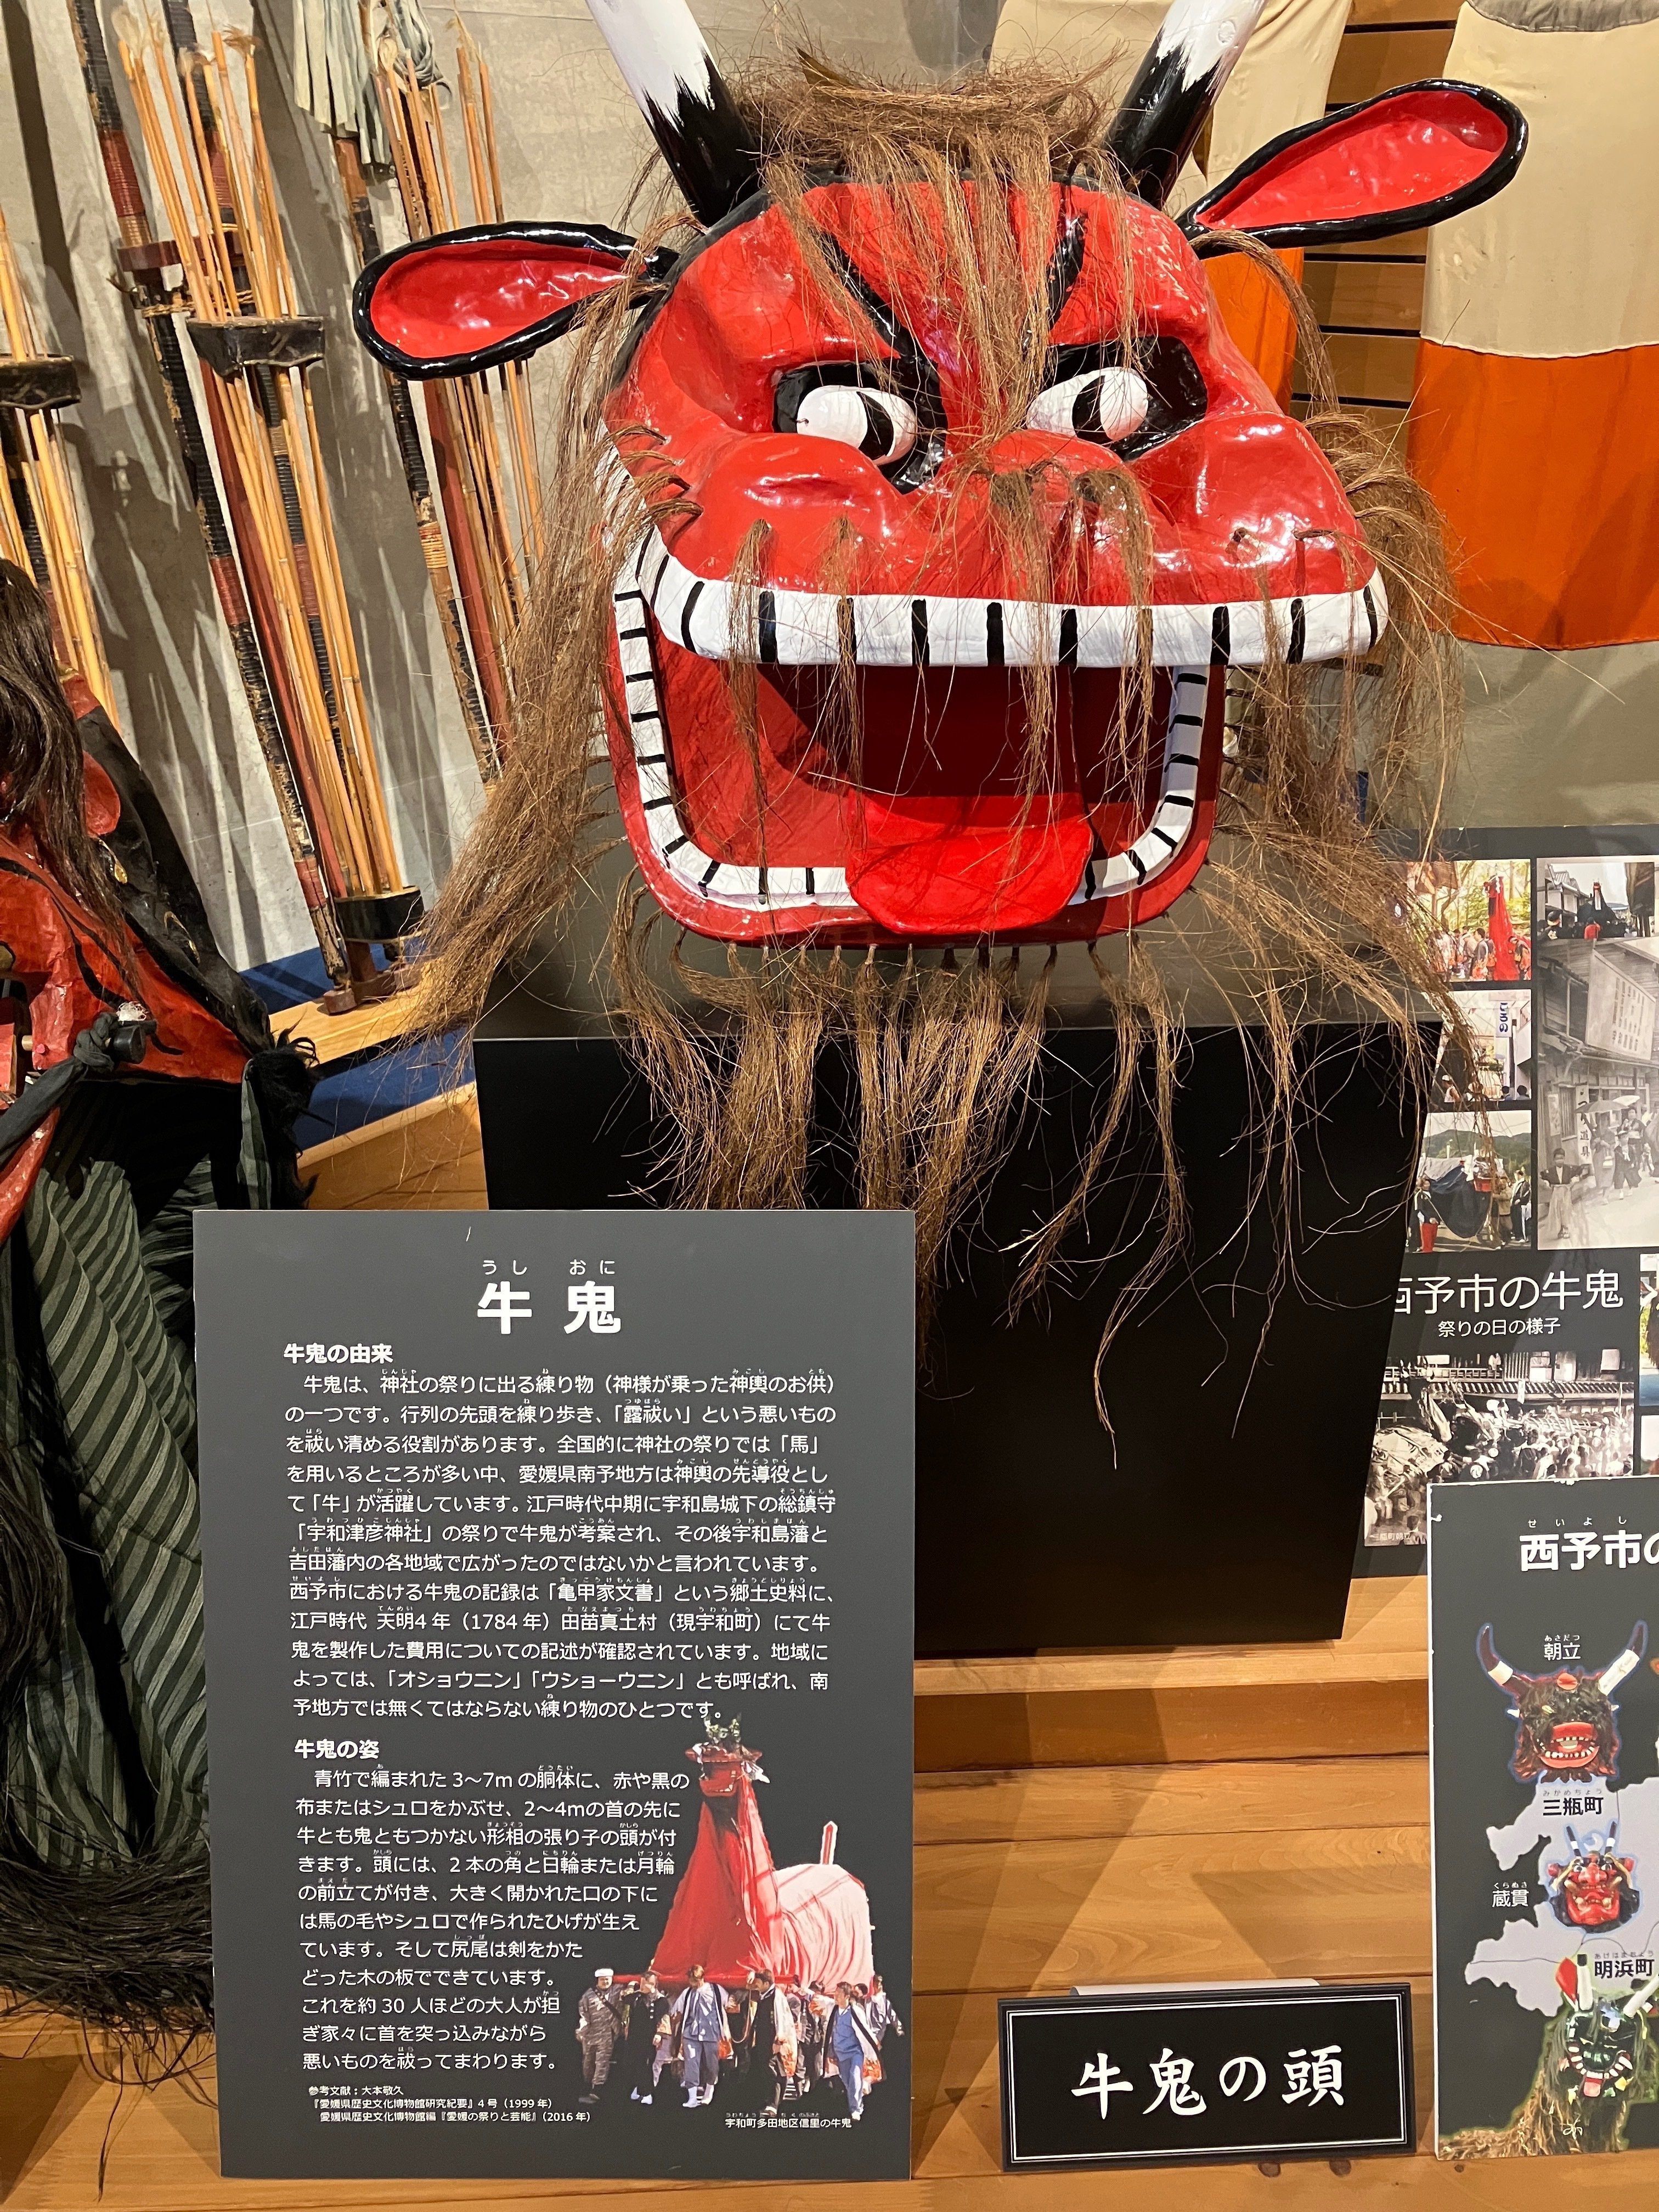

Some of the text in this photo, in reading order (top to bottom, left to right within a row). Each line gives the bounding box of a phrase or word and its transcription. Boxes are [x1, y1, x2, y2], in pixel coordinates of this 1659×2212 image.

[482, 1259, 615, 1276] うし おに
[477, 1280, 621, 1335] 牛 鬼
[1438, 1317, 1561, 1338] 祭りの日の様子
[283, 1342, 393, 1364] 牛鬼の由来
[303, 1374, 834, 1394] 牛鬼は、神社の祭りに出る練り物（神様が乗った神輿のお供）
[285, 1404, 836, 1424] の一つです。行列の先頭を練り歩き、「露祓い」という悪いもの
[286, 1434, 817, 1454] を祓い清める役割があります。全国的に神社の祭りでは「馬」
[287, 1464, 828, 1484] を用いるところが多い中、愛媛県南予地方は神輿の先導役とし
[287, 1493, 836, 1514] て「牛」が活躍しています。江戸時代中期に宇和島城下の総鎮守
[1527, 1516, 1627, 1528] せいよし
[298, 1523, 827, 1543] 「宇和津彦神社」の祭りで牛鬼が考案され、その後宇和島藩と
[288, 1553, 817, 1573] 吉田藩内の各地域で広がったのではないかと言われています。
[289, 1582, 833, 1602] 西予市における牛鬼の記録は「亀甲家文書」という郷土史料に、
[290, 1611, 367, 1630] 江戸時代
[1544, 1634, 1580, 1642] あさだつ
[291, 1640, 828, 1661] 鬼を製作した費用についての記述が確認されています。地域に
[1544, 1642, 1581, 1661] 朝立
[293, 1669, 828, 1690] よっては、「オショウニン」「ウショーウニン」とも呼ばれ、南
[293, 1698, 721, 1719] 予地方では無くてはならない練り物のひとつです。
[294, 1738, 380, 1759] 牛鬼の姿
[1543, 1797, 1604, 1816] 三瓶町
[297, 1825, 677, 1847] 牛とも鬼ともつかない形相の張り子の頭が付
[298, 1855, 675, 1875] きます。頭には、2本の角と日輪または月輪
[298, 1883, 658, 1903] の前立てが付き、大きく開かれた口の下に
[1492, 1889, 1530, 1908] 蔵貫
[300, 1912, 640, 1931] は馬の毛やシュロで作られたひげが生え
[300, 1940, 583, 1958] ています。そして尻尾は剣をかた
[302, 1968, 554, 1986] どった木の板でできています。
[1594, 1959, 1655, 1979] 明浜町
[302, 2024, 546, 2042] ぎ家々に首を突っ込みながら
[303, 2052, 555, 2070] 悪いものを祓ってまわります。
[308, 2085, 404, 2096] 参考文献：大本敬久
[1071, 2045, 1344, 2120] 牛鬼の頭
[724, 2118, 853, 2129] 宇和町多田地区信里の牛鬼
